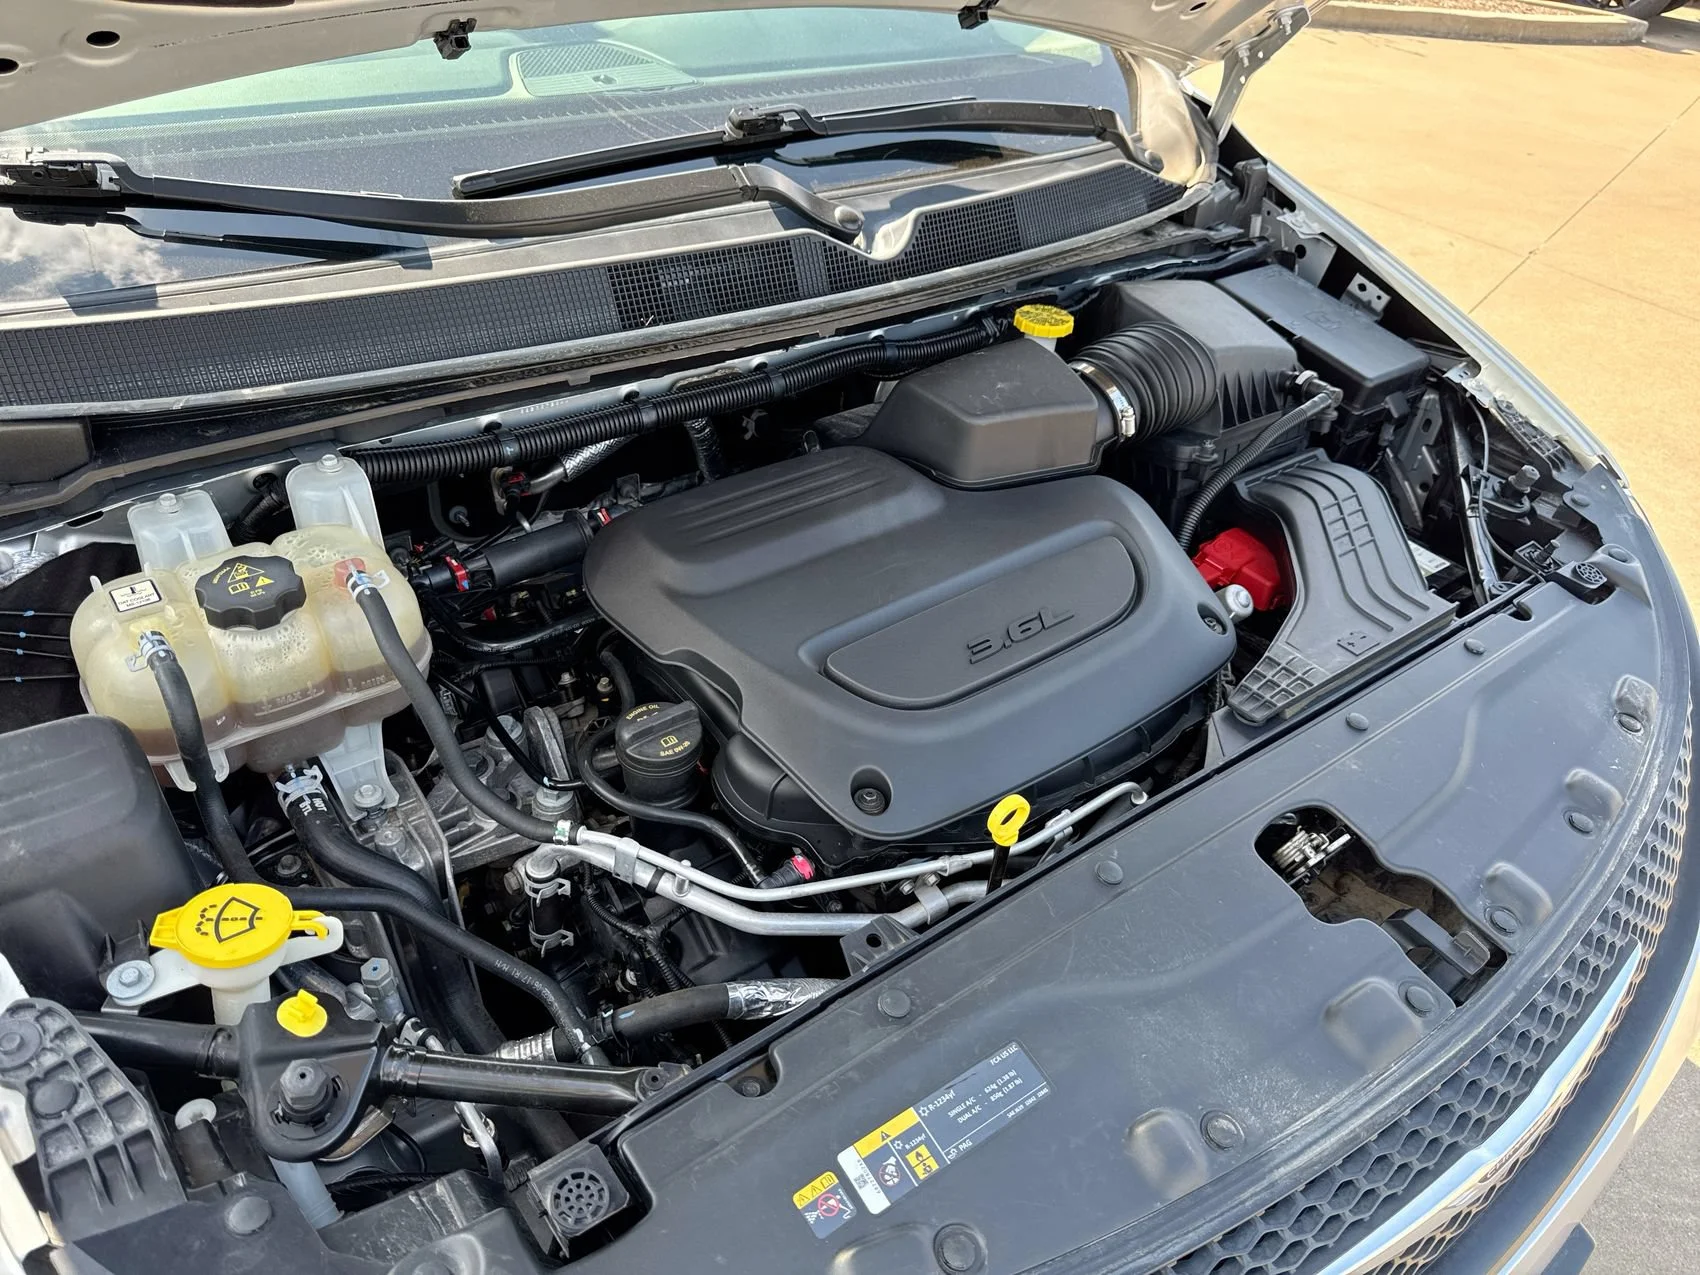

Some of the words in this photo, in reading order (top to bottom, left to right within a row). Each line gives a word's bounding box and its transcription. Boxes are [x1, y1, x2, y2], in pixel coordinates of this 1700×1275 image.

[966, 606, 1075, 665] 3.6L
[626, 706, 648, 720] ENGINE
[660, 749, 674, 757] SAE
[1001, 1050, 1010, 1059] US
[1007, 1044, 1018, 1055] LLC
[928, 1089, 956, 1112] R-1234yf
[947, 1103, 967, 1118] SINGLE
[965, 1096, 977, 1106] A/C
[957, 1111, 972, 1124] DUAL
[971, 1104, 982, 1115] A/C
[958, 1138, 973, 1152] PAG
